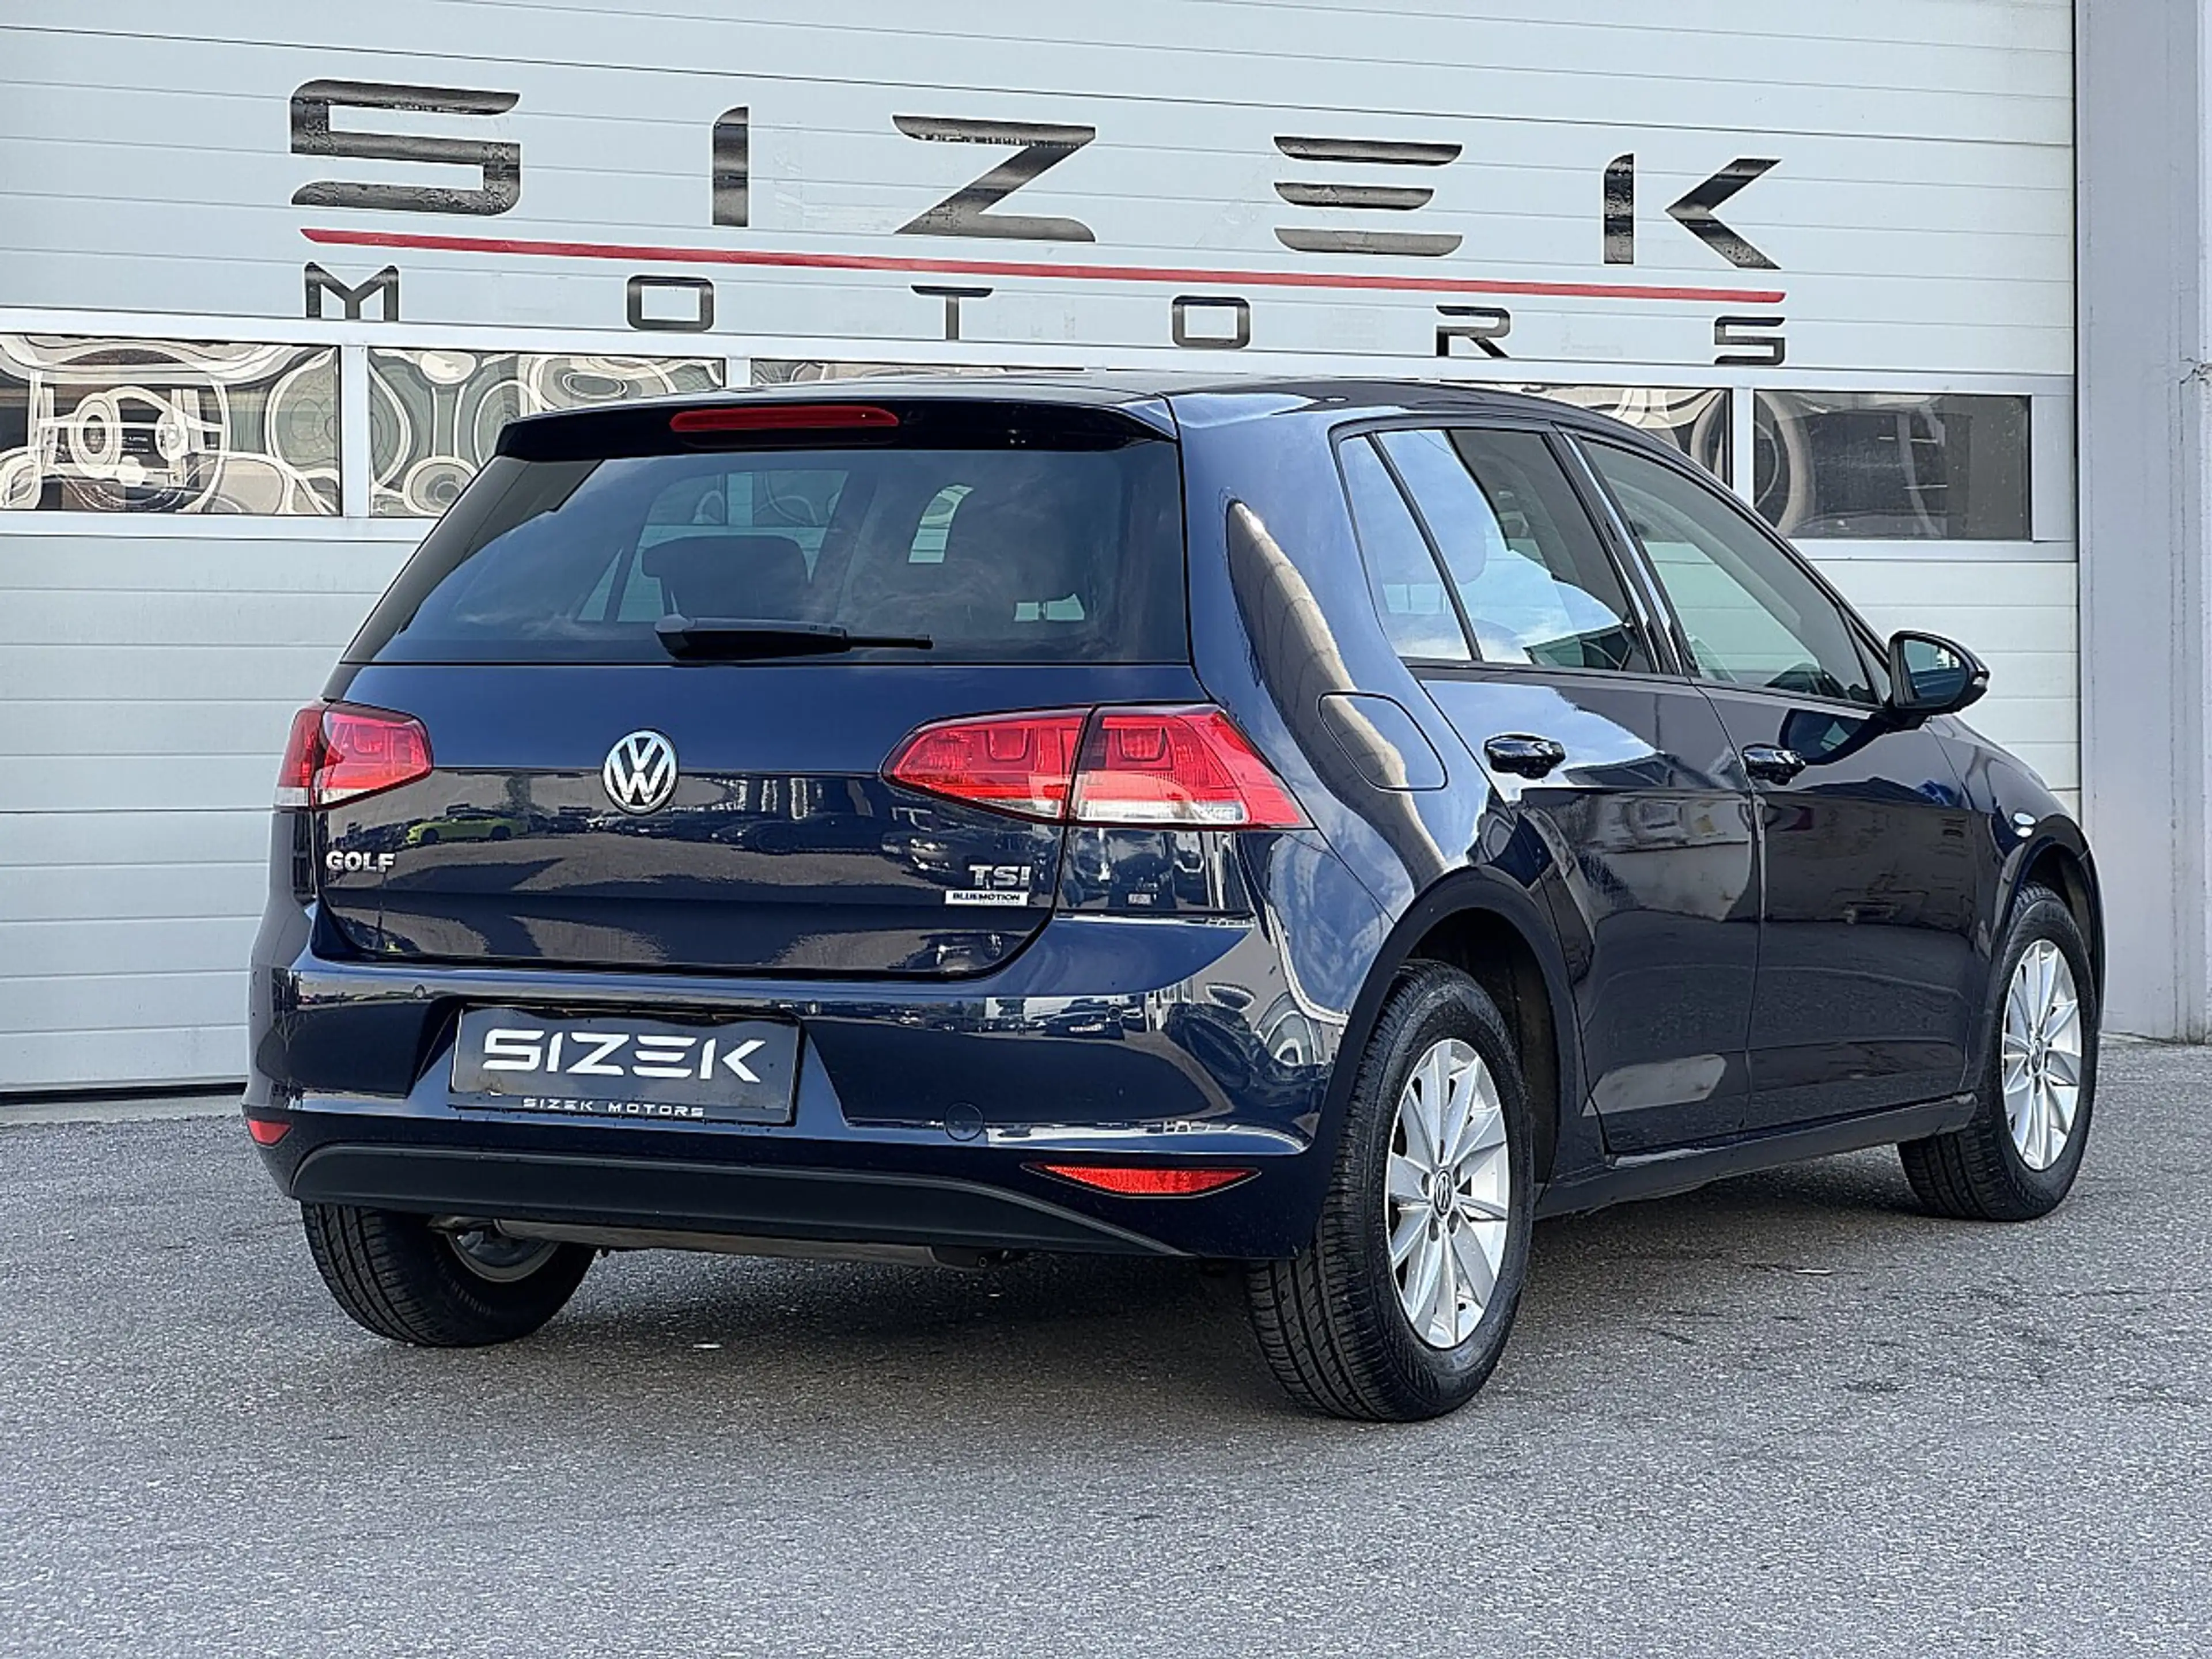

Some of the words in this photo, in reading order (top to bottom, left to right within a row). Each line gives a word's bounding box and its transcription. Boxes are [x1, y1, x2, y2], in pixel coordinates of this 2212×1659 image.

[291, 79, 1782, 270] SIZEK
[305, 261, 1786, 366] MOTORS
[326, 850, 395, 873] GOLF
[969, 865, 1031, 887] TSI
[952, 892, 1020, 900] BLUEMOTION
[482, 1028, 766, 1084] SIZEK
[522, 1097, 594, 1111] SIZEK
[608, 1103, 704, 1117] MOTORS
